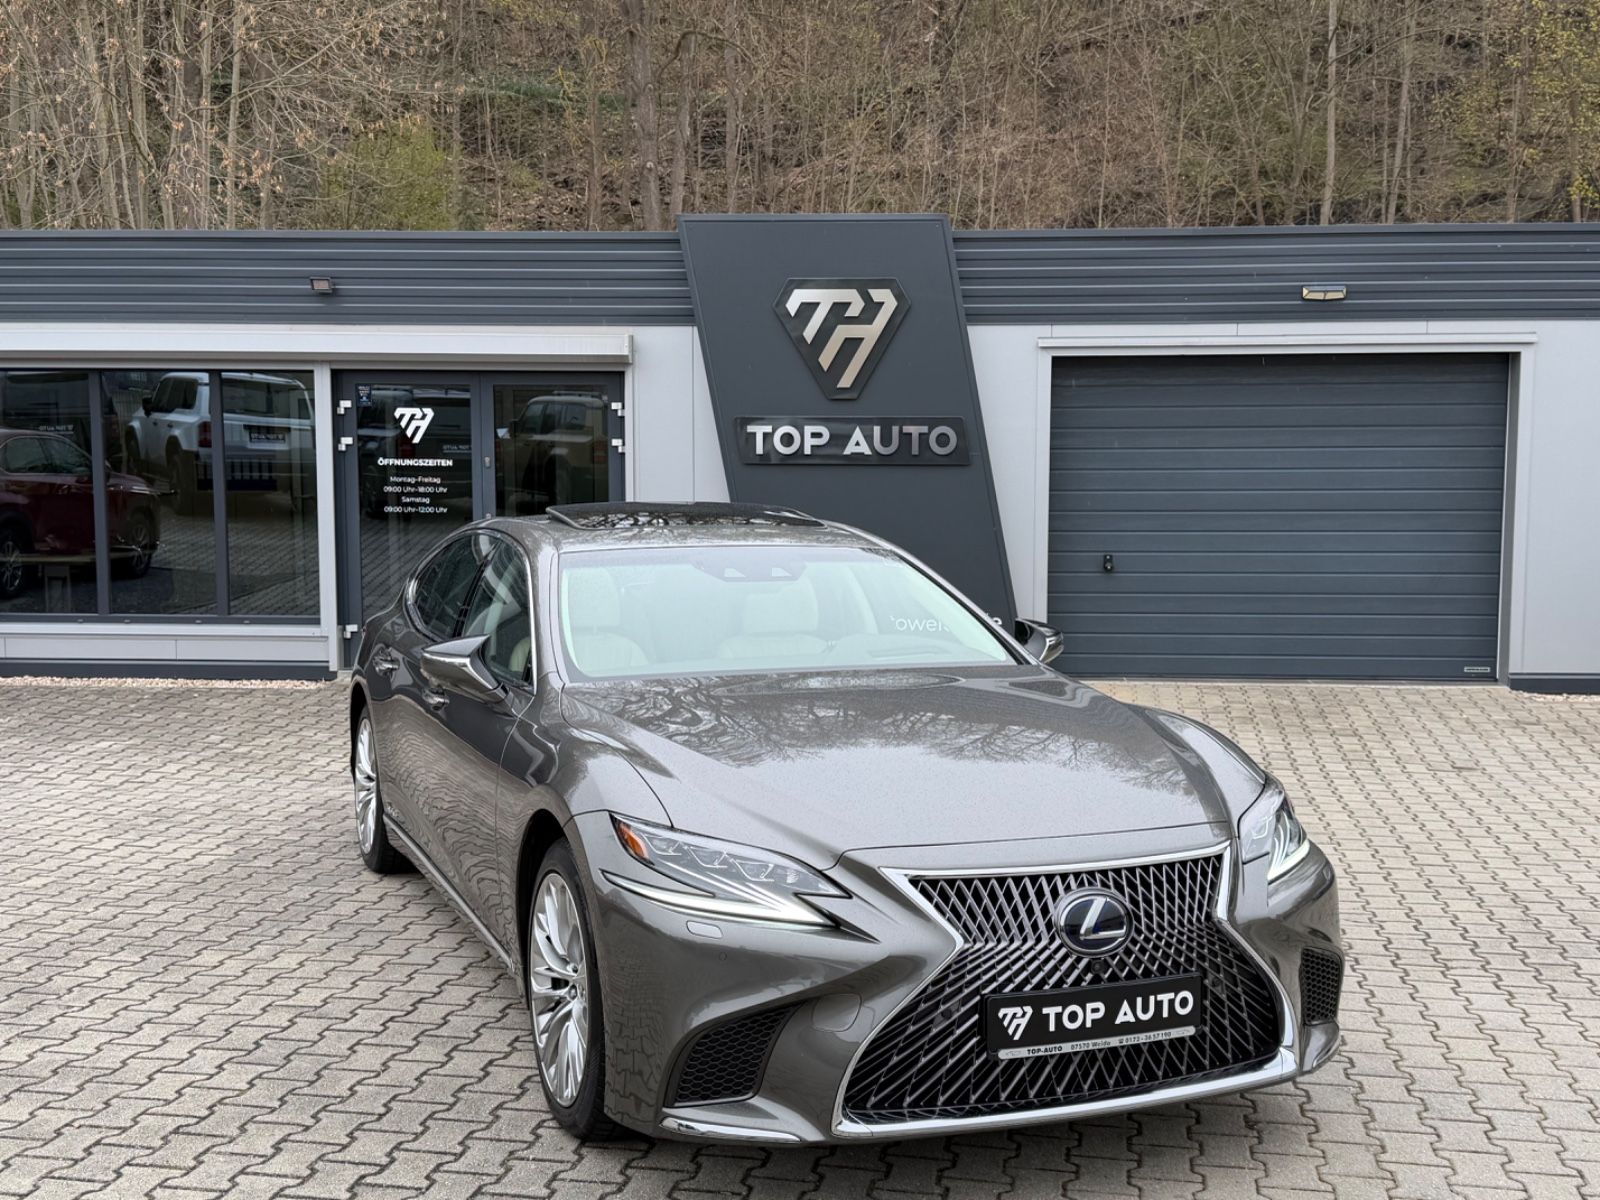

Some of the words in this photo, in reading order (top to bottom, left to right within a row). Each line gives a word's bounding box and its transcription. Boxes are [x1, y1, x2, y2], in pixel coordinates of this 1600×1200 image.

[747, 425, 830, 456] TOP
[842, 425, 958, 456] AUTO
[377, 456, 453, 467] ÖFFNUNGSZEITEN
[389, 476, 441, 484] Montag-Freitag
[401, 496, 430, 504] Samstag
[383, 505, 402, 513] 09:00
[1042, 1001, 1105, 1032] TOP
[1114, 990, 1194, 1025] AUTO
[1026, 1045, 1063, 1056] TOP-AUTO
